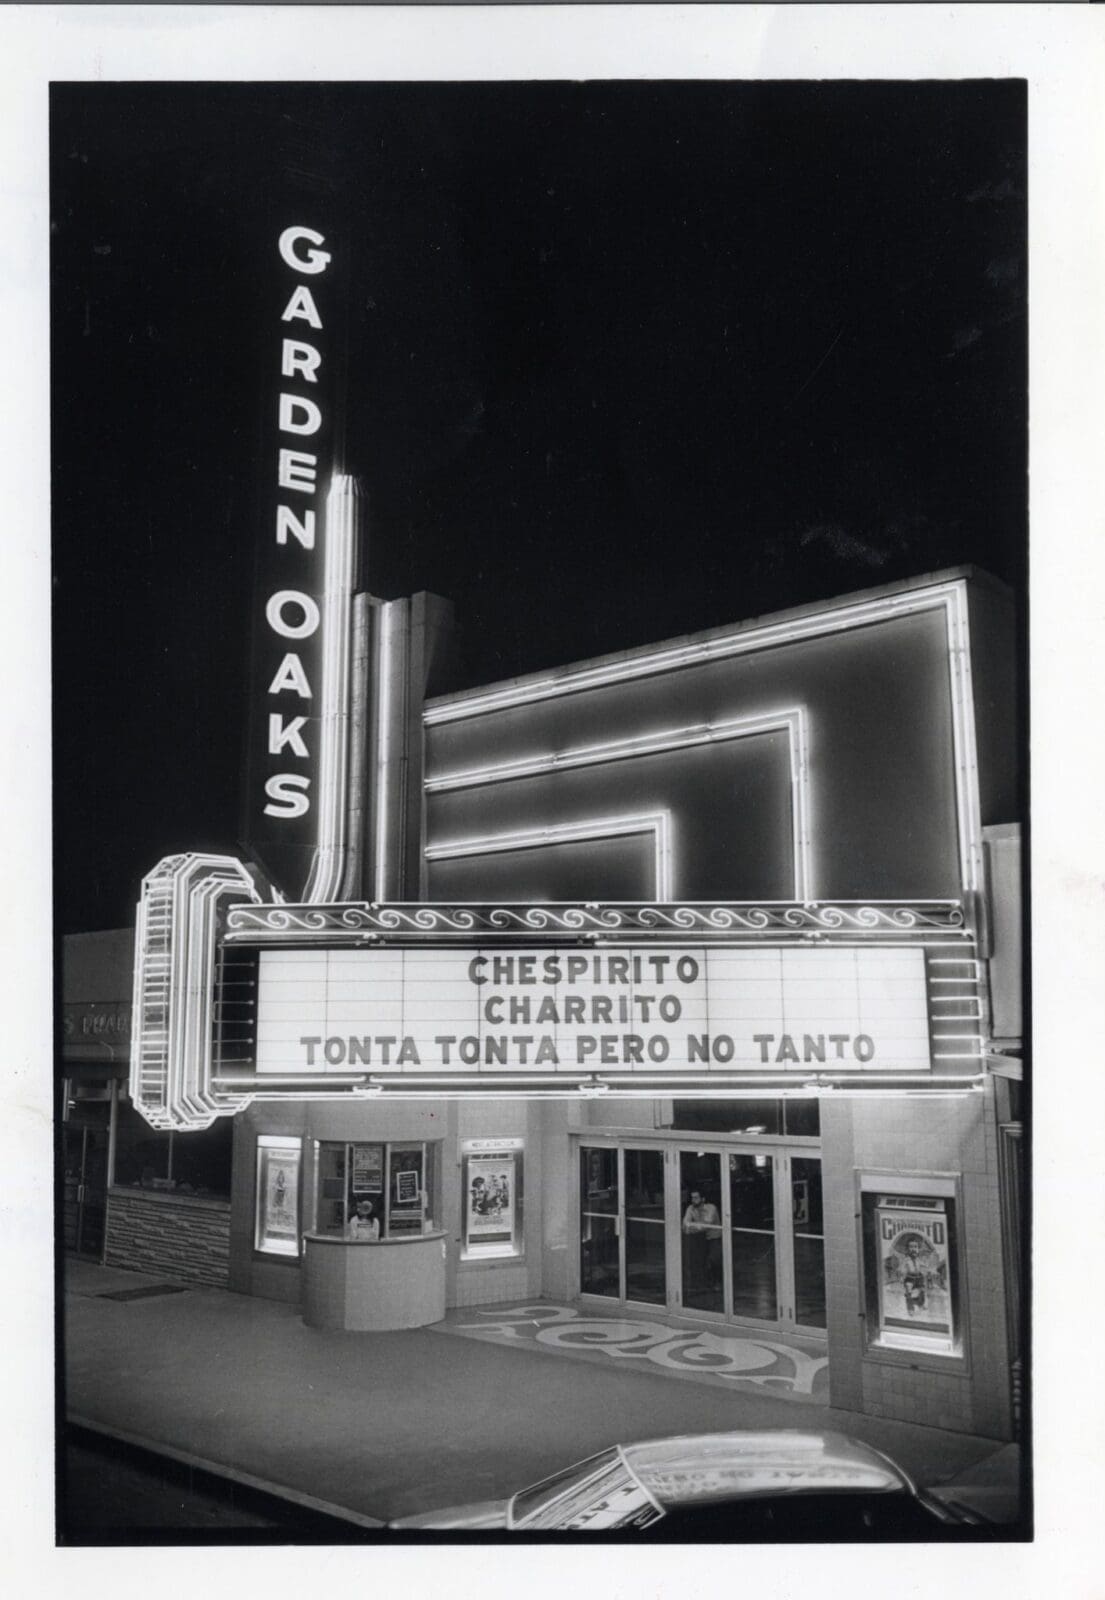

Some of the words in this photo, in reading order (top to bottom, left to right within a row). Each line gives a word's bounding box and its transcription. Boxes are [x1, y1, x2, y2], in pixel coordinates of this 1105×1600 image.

[276, 226, 331, 549] GARDEN
[263, 589, 320, 819] OAKS
[468, 955, 699, 985] CHESPIRITO
[484, 994, 682, 1024] CHARRITO
[300, 1036, 421, 1065] TONTA
[435, 1035, 560, 1065] TONTA
[576, 1034, 669, 1064] PERO
[687, 1034, 735, 1063] NO
[753, 1034, 875, 1063] TANTO
